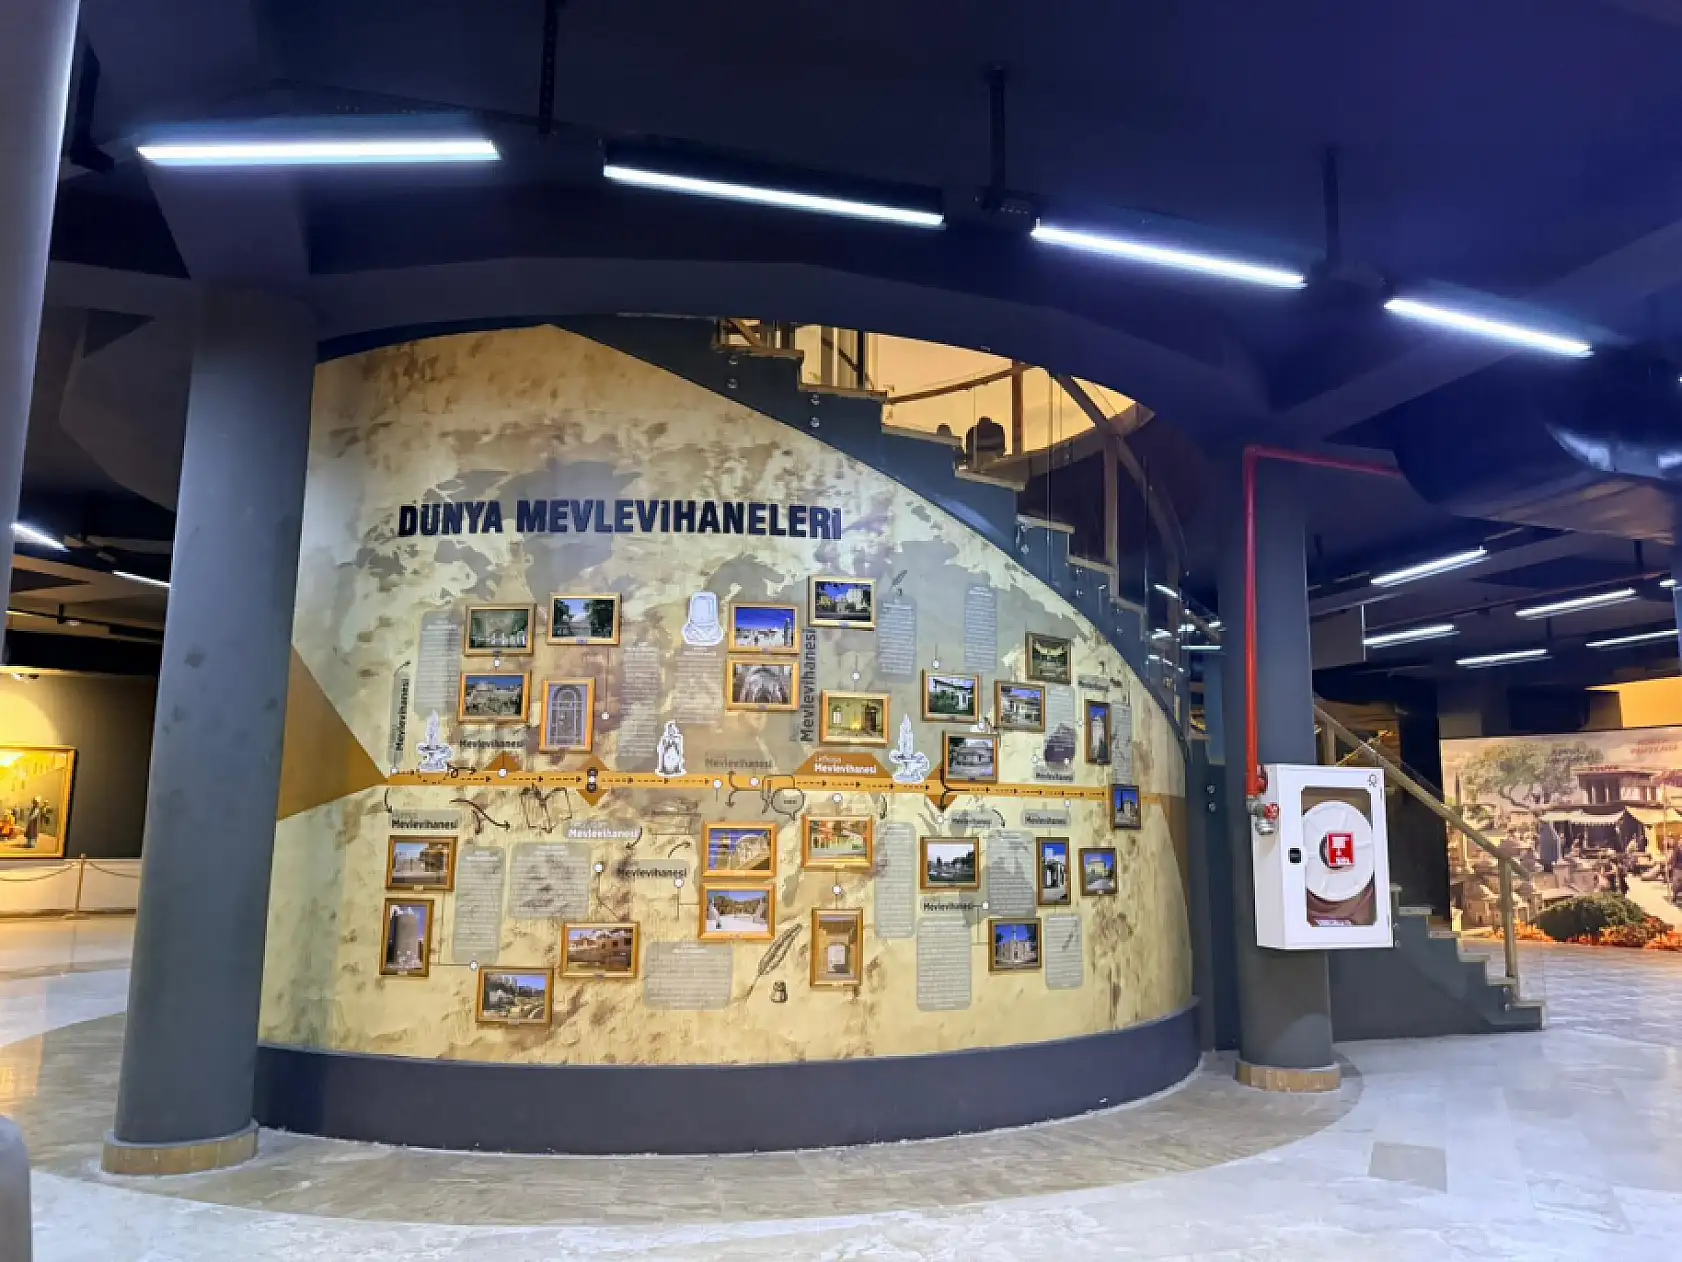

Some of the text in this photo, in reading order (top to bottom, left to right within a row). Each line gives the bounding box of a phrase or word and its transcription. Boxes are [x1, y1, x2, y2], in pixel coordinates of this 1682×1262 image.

[398, 499, 842, 540] DÜNYA MEVLEVİHANELERİ
[800, 628, 817, 742] Mevlevihanesi
